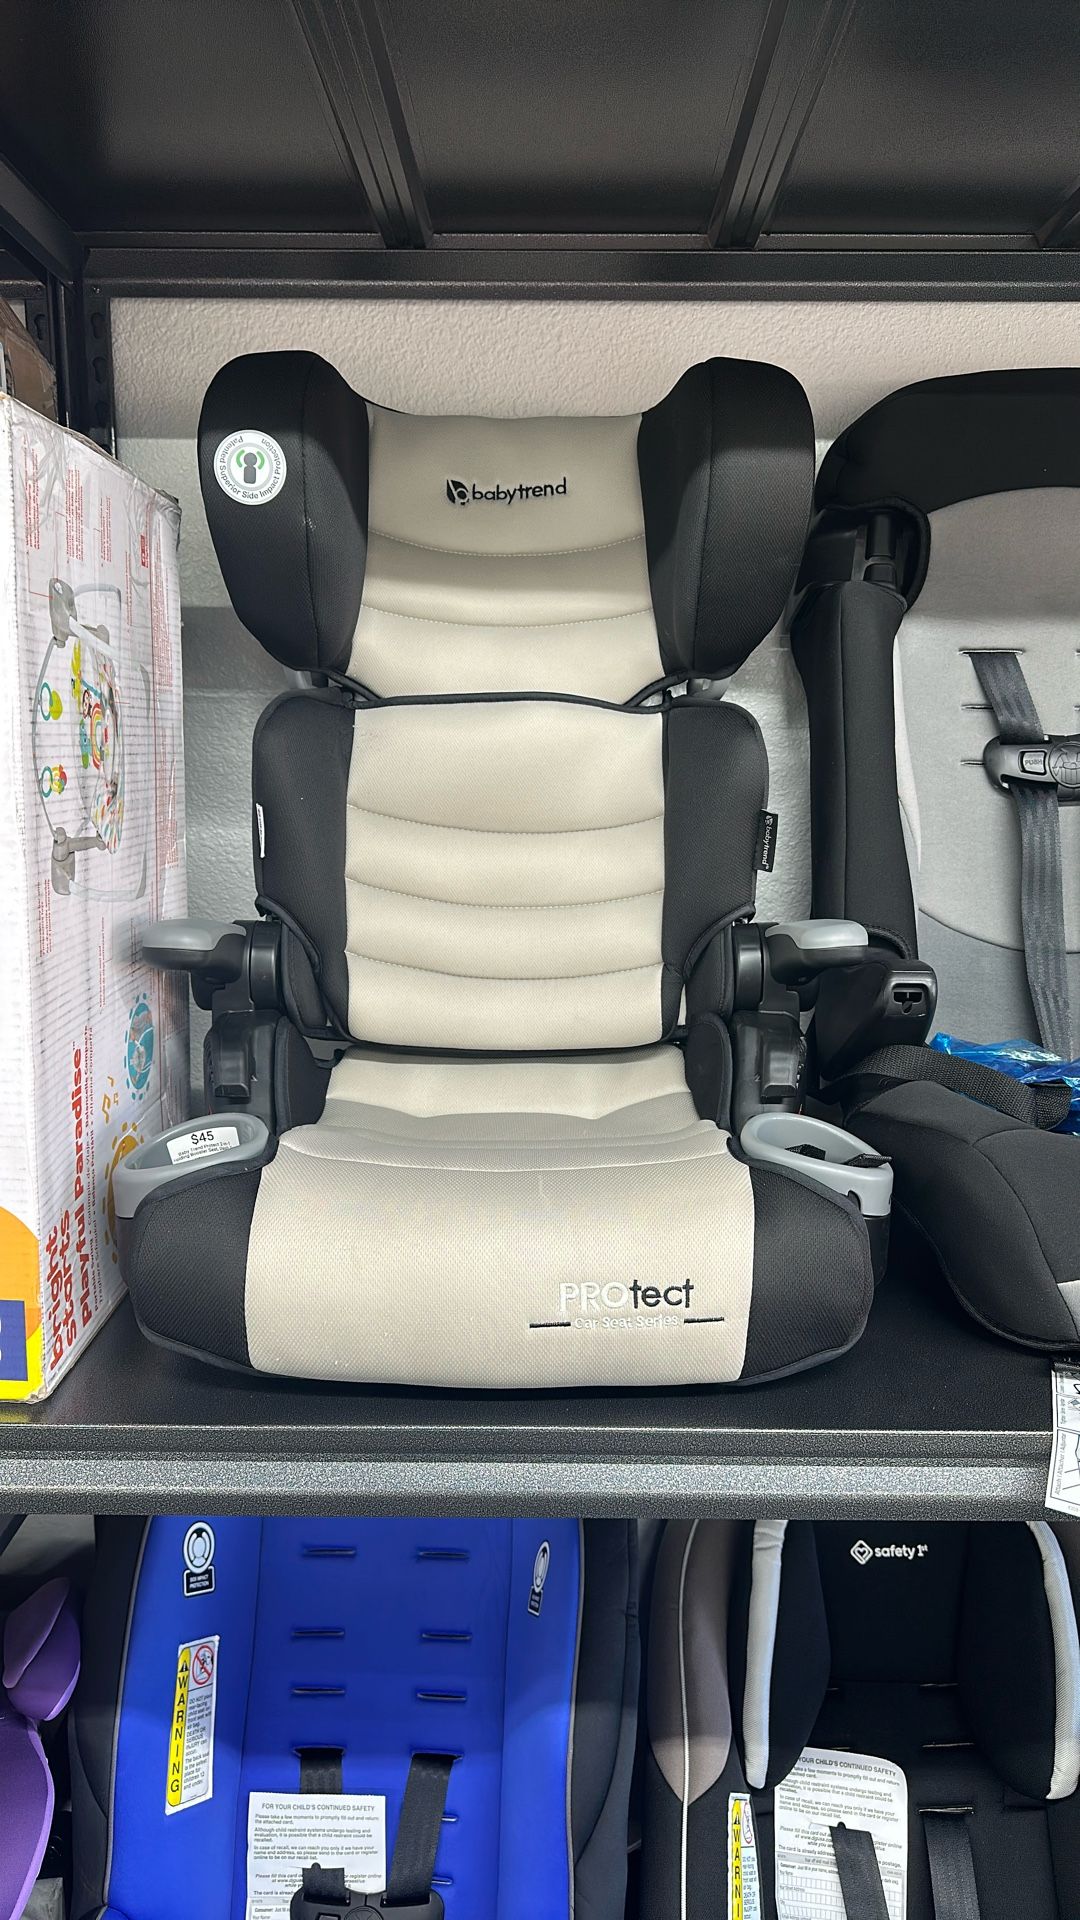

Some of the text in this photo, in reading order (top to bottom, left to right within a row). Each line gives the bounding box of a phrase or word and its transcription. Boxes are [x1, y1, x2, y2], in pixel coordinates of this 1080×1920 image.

[220, 436, 281, 499] Patented Superior Side Impact Protection
[472, 476, 567, 505] babytrend
[190, 1130, 215, 1145] $45
[58, 1209, 77, 1346] starts
[74, 1202, 92, 1327] Playful
[45, 1226, 64, 1371] bright
[559, 1278, 694, 1312] PROtect
[574, 1314, 679, 1329] Car Seat Series
[874, 1544, 915, 1560] safety
[170, 1678, 189, 1794] WARNING
[815, 1758, 838, 1766] CHILD'S
[839, 1762, 873, 1772] CONTINUED
[873, 1766, 896, 1777] SAFETY
